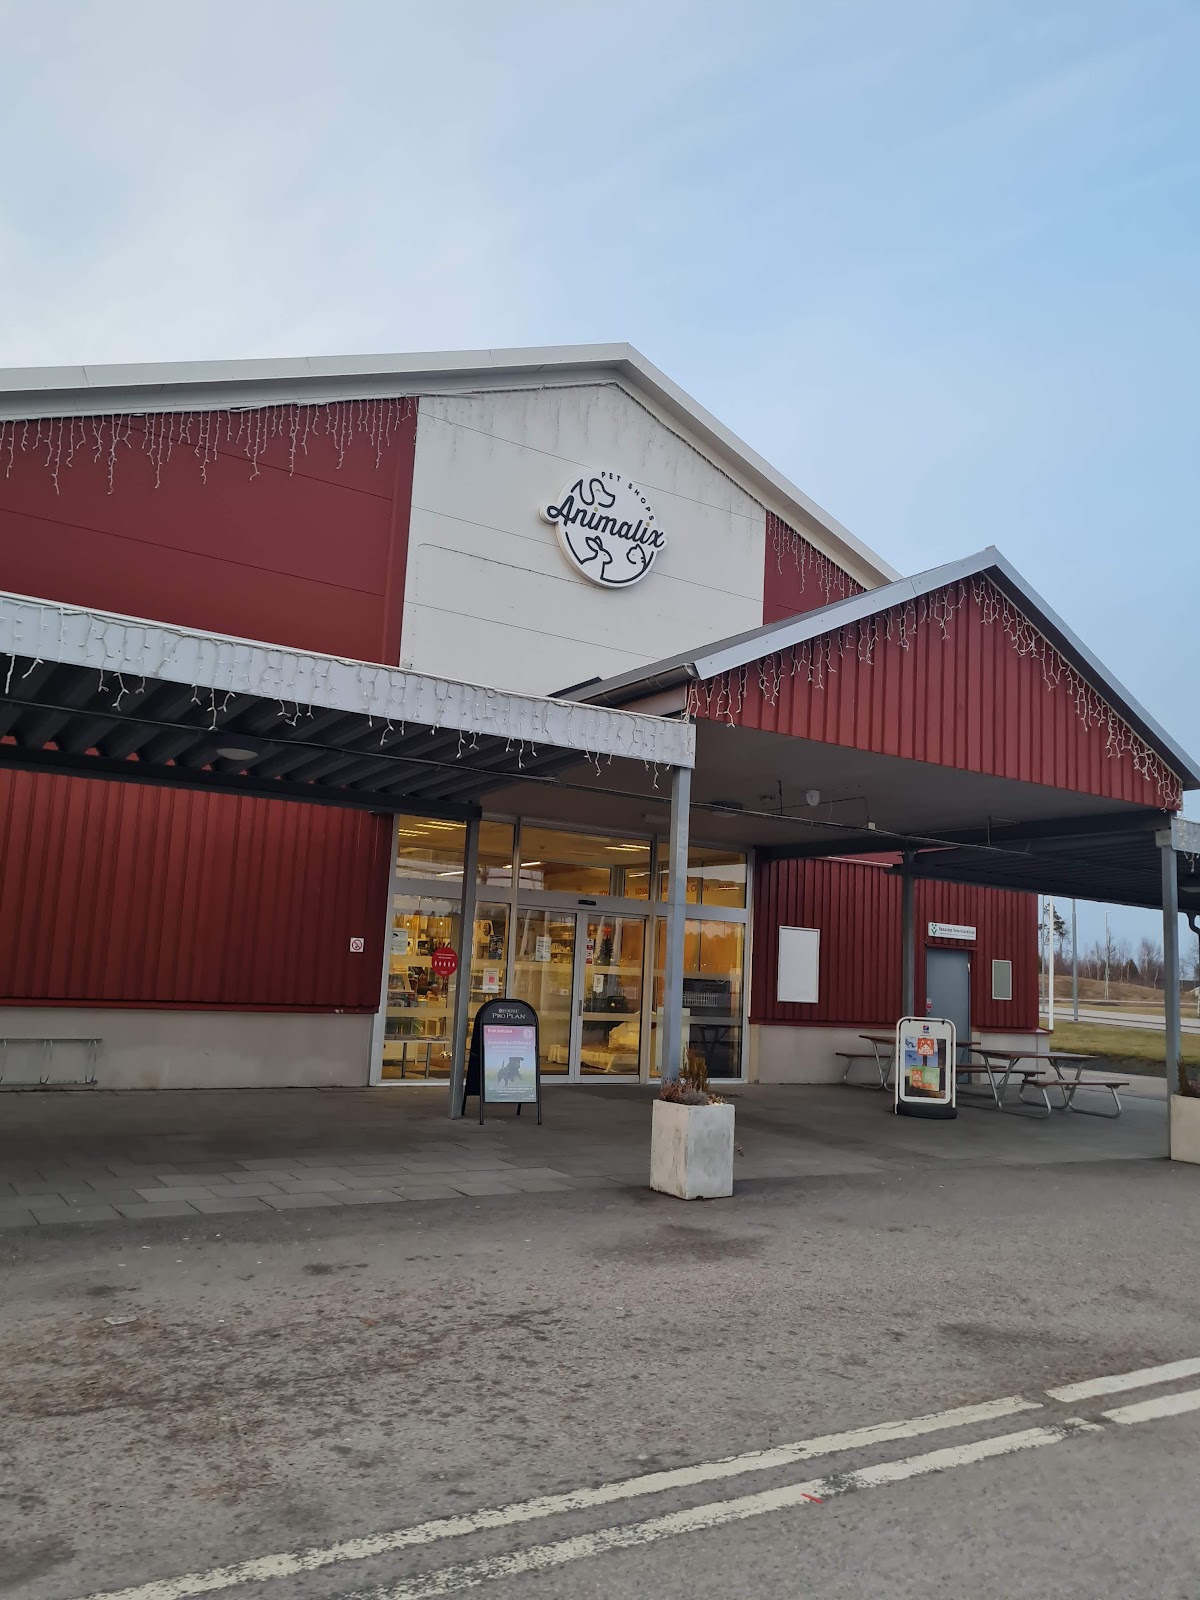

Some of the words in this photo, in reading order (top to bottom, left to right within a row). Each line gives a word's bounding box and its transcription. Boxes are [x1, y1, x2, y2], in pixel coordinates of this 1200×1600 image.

[546, 494, 665, 549] Animalix
[601, 471, 621, 482] PET
[628, 482, 655, 521] SHOPS
